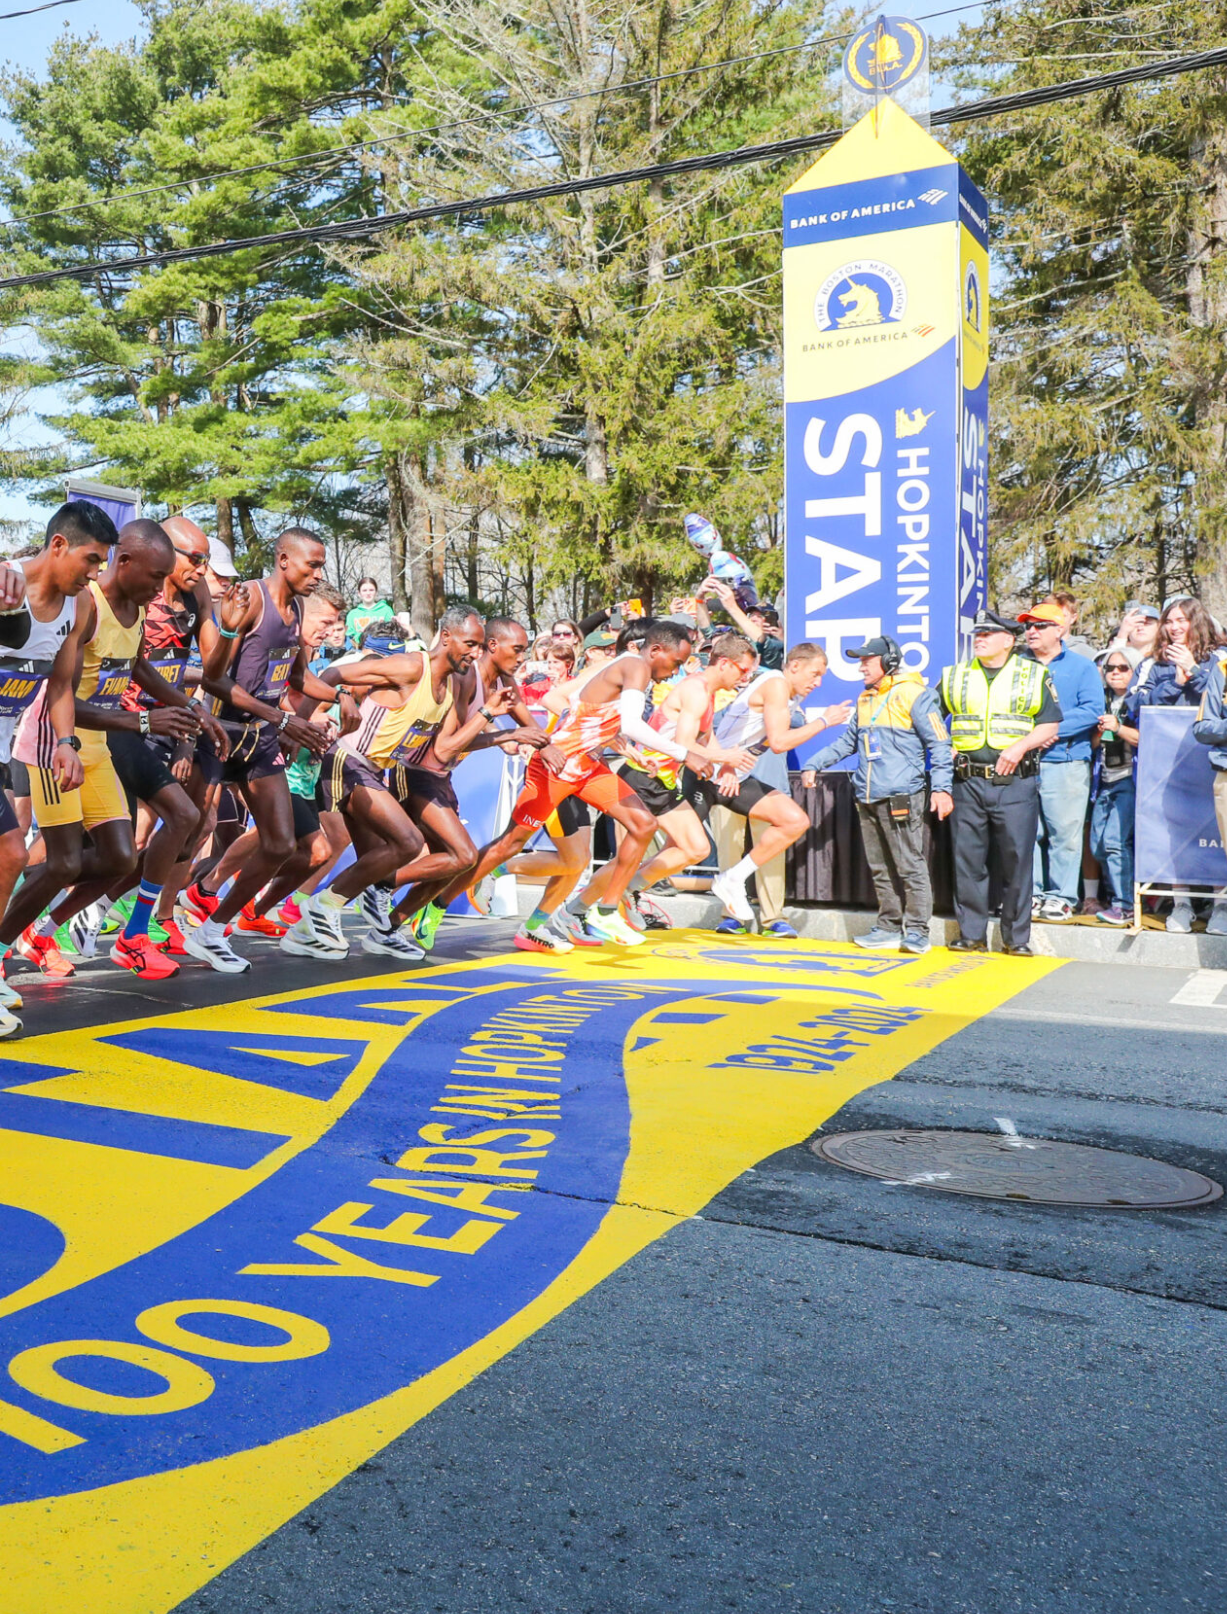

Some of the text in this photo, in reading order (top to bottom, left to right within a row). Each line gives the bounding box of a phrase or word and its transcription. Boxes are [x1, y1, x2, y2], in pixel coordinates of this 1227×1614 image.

[790, 198, 916, 230] BANK OF AMERICA
[817, 263, 905, 323] THE BOSTON MARATHON
[802, 332, 909, 352] BANK OF AMERICA
[896, 447, 930, 686] HOPKINTO
[449, 982, 694, 1083] HOPKINTON
[705, 1003, 934, 1074] 1924-2024
[429, 1084, 562, 1120] IN
[236, 1121, 557, 1288] YEARS
